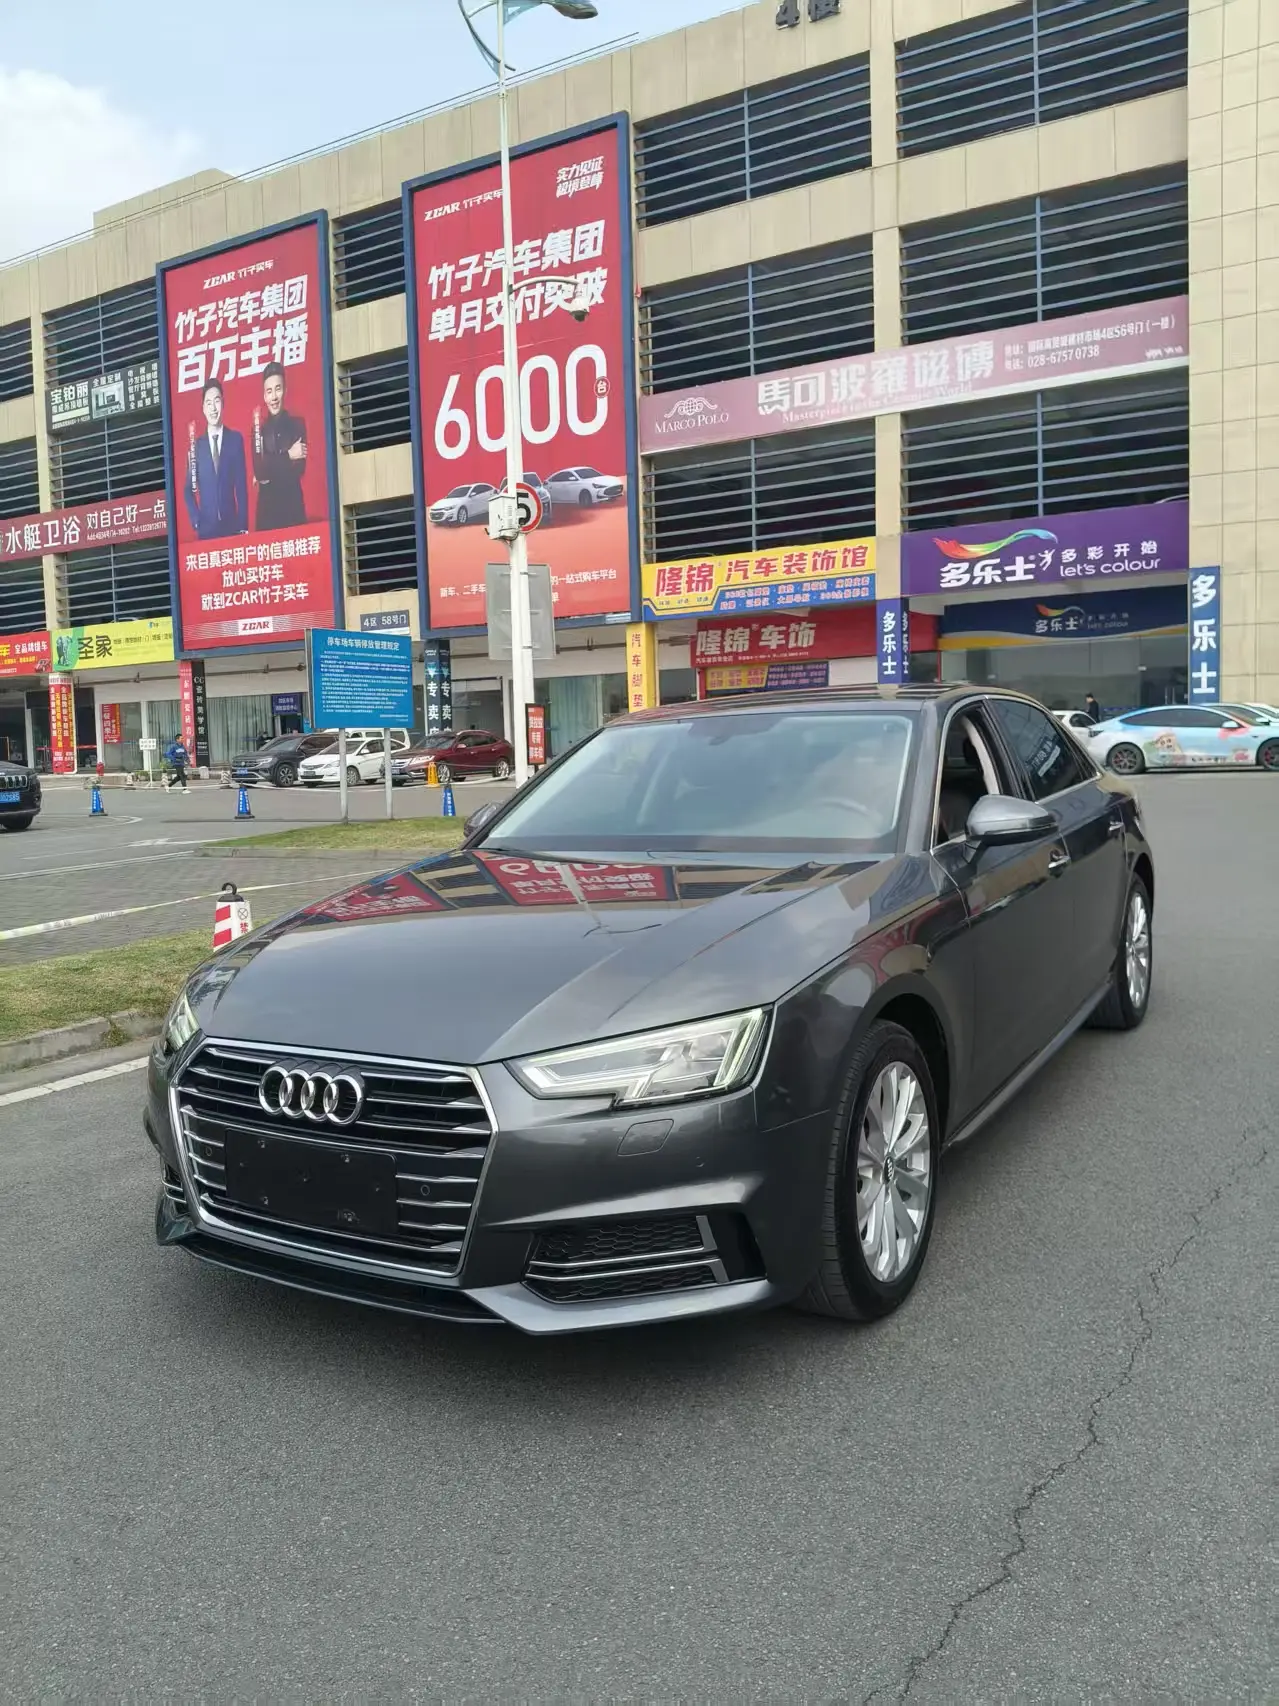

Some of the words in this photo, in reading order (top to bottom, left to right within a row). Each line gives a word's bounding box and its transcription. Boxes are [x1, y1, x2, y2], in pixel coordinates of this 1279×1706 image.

[556, 156, 605, 183] 实力见证
[424, 202, 461, 222] ZCAR
[427, 220, 606, 300] 竹子汽车集团
[203, 271, 236, 289] ZCAR
[238, 259, 274, 278] 竹子买车
[175, 274, 308, 344] 竹子汽车集团
[177, 312, 309, 393] 百万主播
[50, 381, 89, 405] 宝铂丽
[93, 372, 121, 388] 全屋定制
[434, 344, 609, 460] 6000
[654, 417, 696, 433] MARCO
[697, 411, 729, 426] POLO
[5, 515, 81, 554] 水艇卫浴
[87, 499, 166, 529] 对自己好一点
[186, 536, 321, 571] 来自真实用户的信赖推荐
[1061, 541, 1158, 562] 多彩开始
[222, 564, 284, 588] 放心买好车
[655, 562, 714, 597] 隆锦
[726, 545, 869, 582] 汽车装饰馆
[939, 556, 1036, 589] 多乐士
[1060, 561, 1095, 577] let's
[1100, 557, 1161, 575] colour
[201, 583, 309, 611] 就到ZCAR竹子买车
[241, 621, 270, 631] ZCAR
[363, 616, 377, 627] 4区
[382, 614, 406, 626] 58号门
[1035, 617, 1078, 633] 多乐士
[77, 635, 113, 660] 圣象
[327, 637, 399, 651] 停车场车辆停放管理规定
[696, 627, 750, 656] 隆锦
[759, 621, 817, 650] 车饰
[882, 610, 897, 675] 多乐士
[1192, 574, 1217, 695] 多乐士
